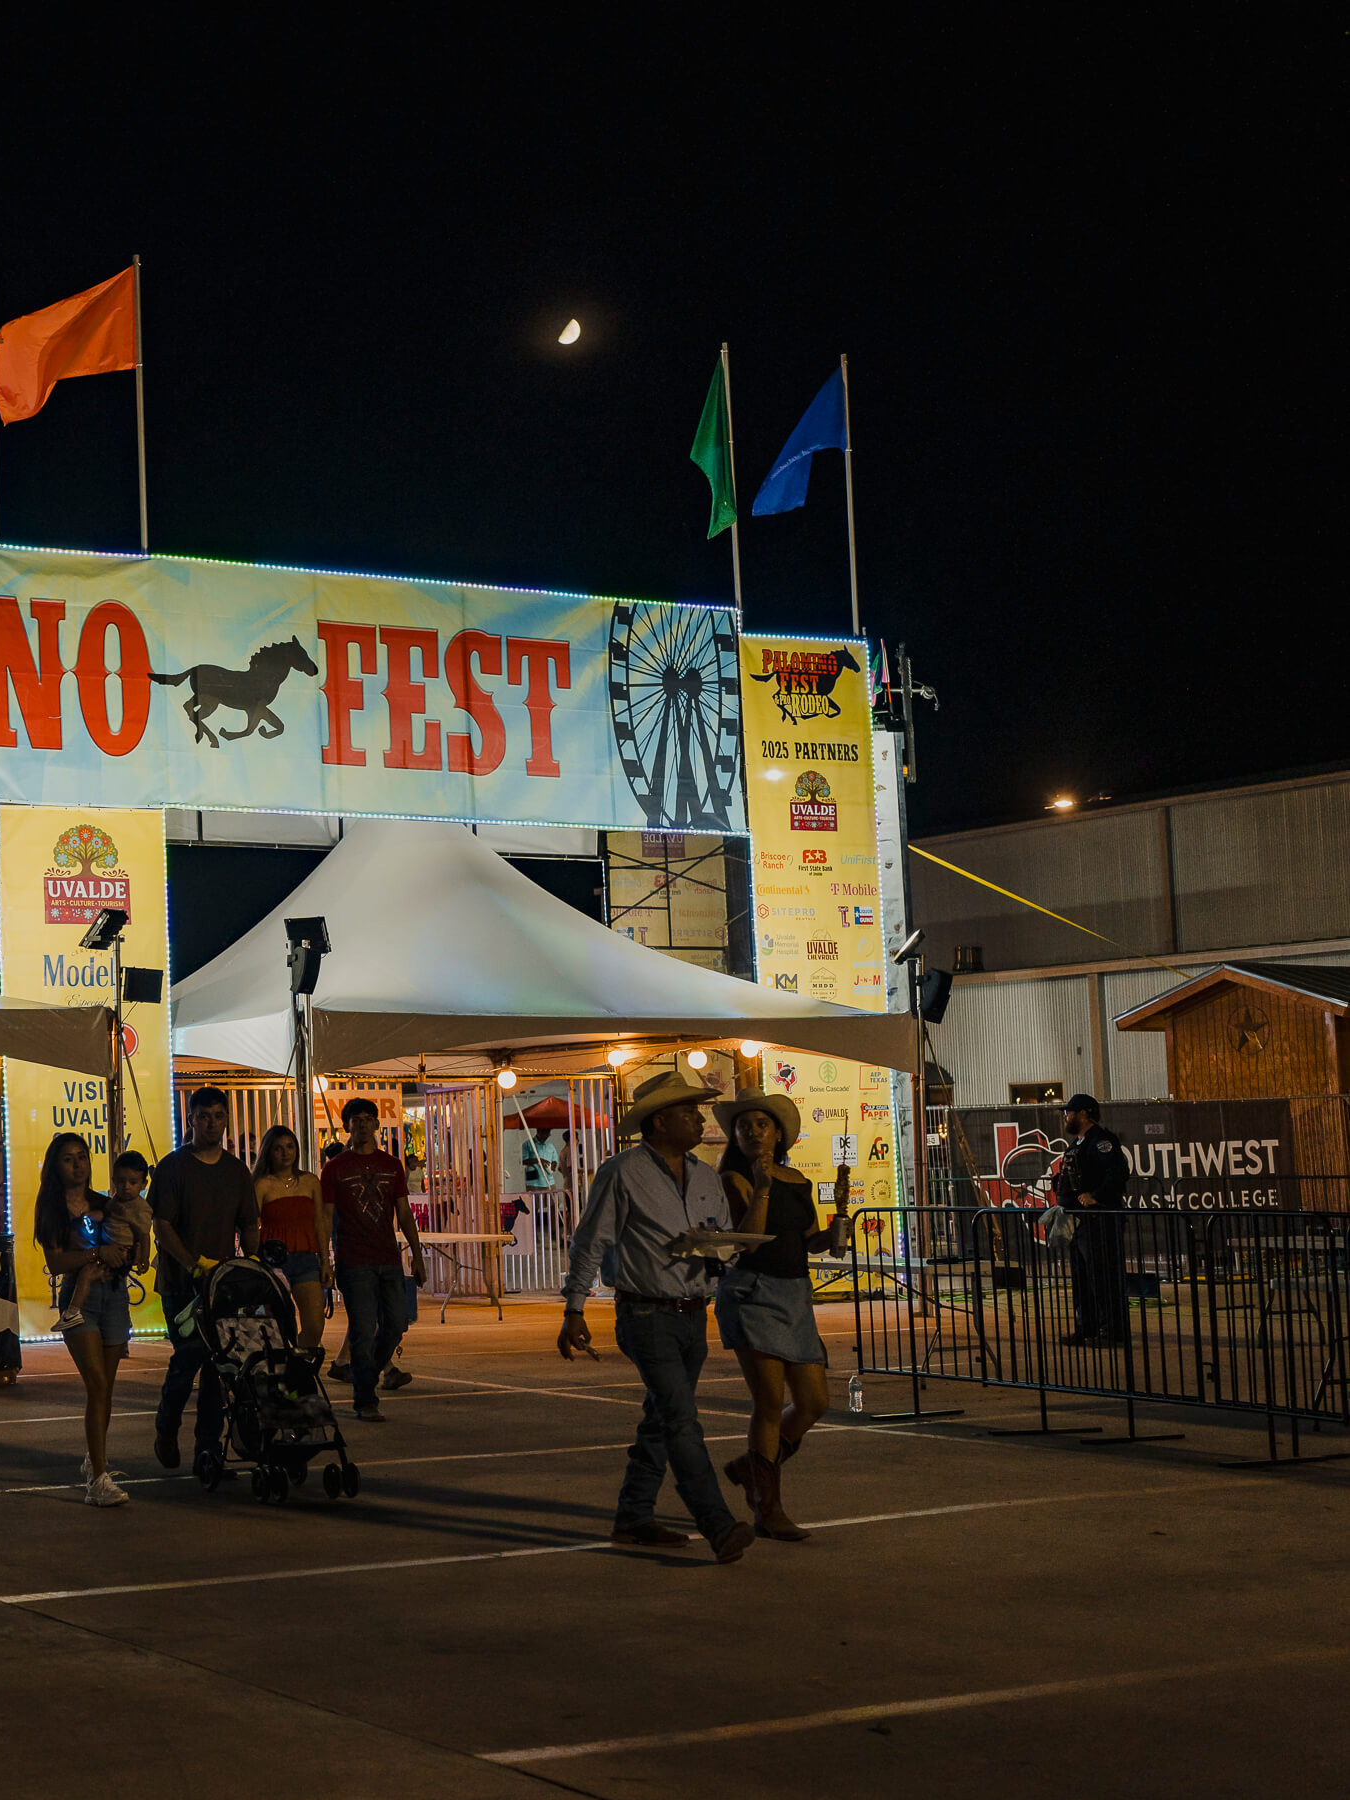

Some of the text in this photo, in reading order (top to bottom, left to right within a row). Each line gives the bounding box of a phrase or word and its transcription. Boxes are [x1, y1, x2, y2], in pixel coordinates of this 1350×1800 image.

[762, 649, 838, 675] PALOMINO
[779, 672, 819, 695] FEST
[317, 619, 571, 778] FEST
[791, 694, 830, 718] RODEO
[762, 740, 859, 762] 2025 PARTNERS
[791, 804, 836, 816] UVALDE
[760, 851, 786, 861] Briscoe
[763, 861, 784, 870] Ranch
[840, 854, 876, 865] UniFirst
[47, 880, 126, 899] UVALDE
[756, 884, 803, 896] Continental
[771, 907, 816, 916] SITEPRO
[806, 942, 839, 954] UVALDE
[43, 954, 116, 987] Model
[63, 1081, 108, 1103] VISI
[825, 1085, 850, 1093] Cascade
[1189, 1189, 1279, 1210] COLLEGE
